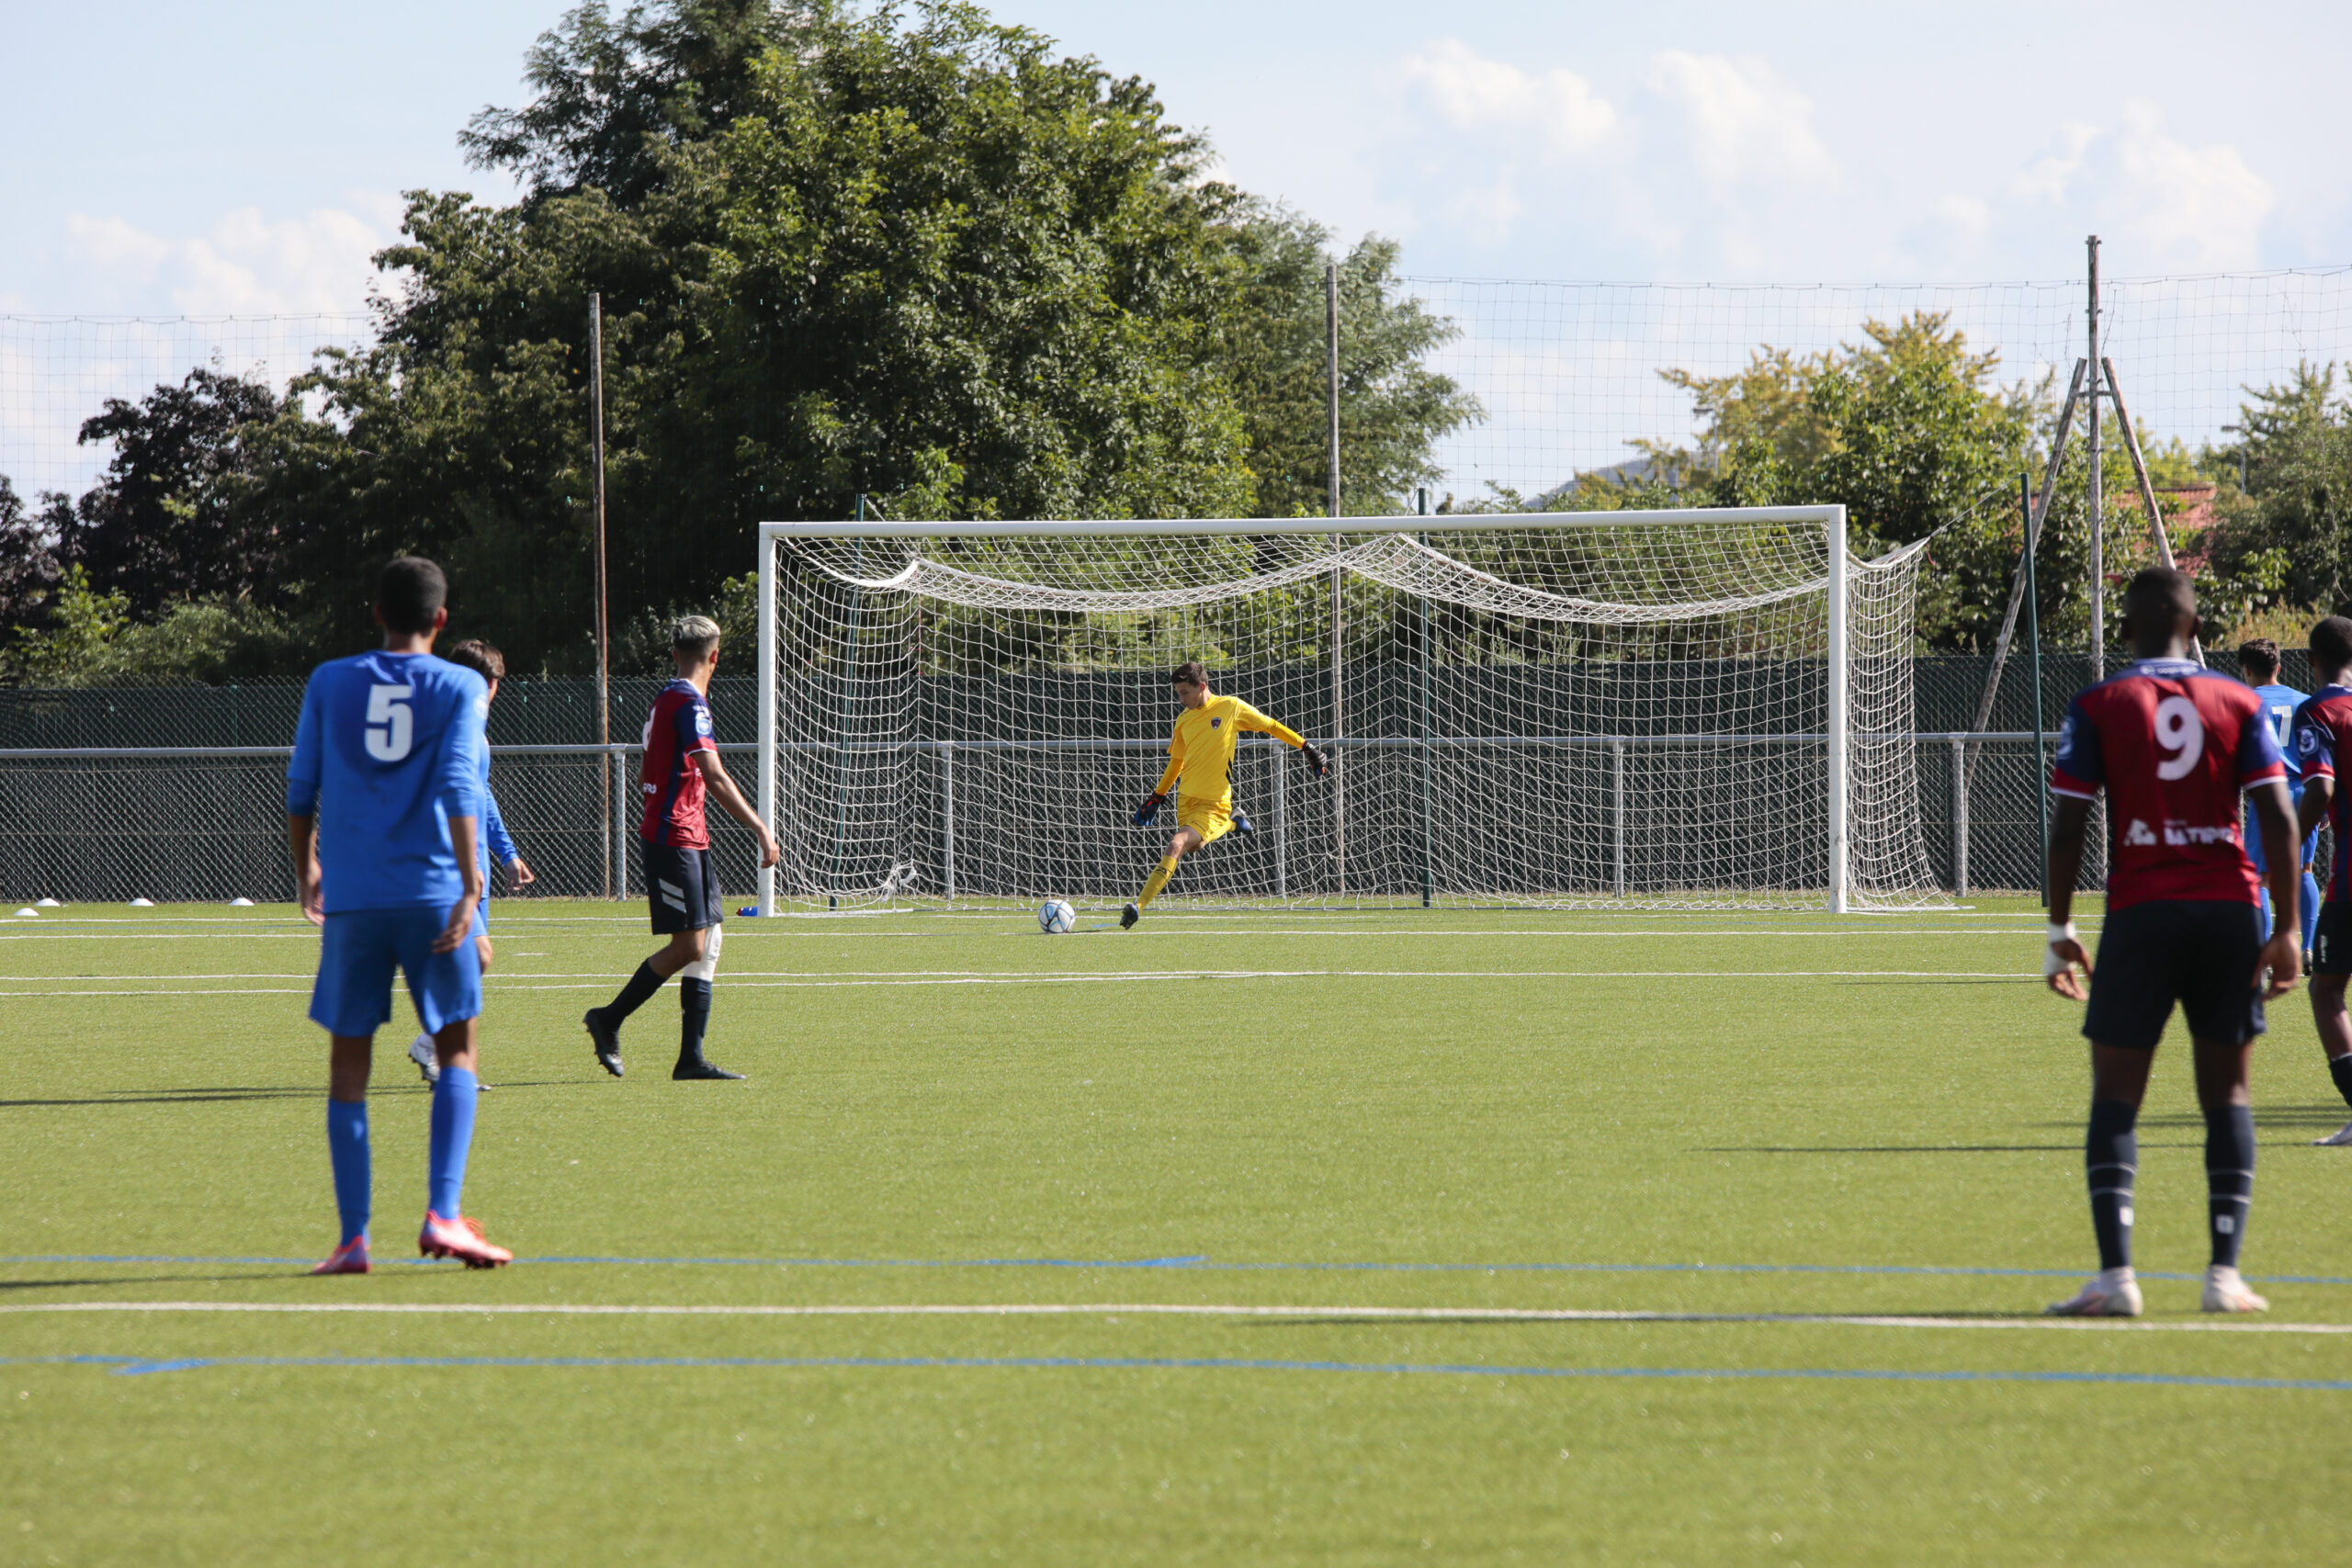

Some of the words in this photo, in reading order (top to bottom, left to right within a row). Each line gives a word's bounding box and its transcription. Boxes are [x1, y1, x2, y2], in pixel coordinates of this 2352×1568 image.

[365, 684, 413, 761] 5
[2154, 695, 2203, 780] 9
[2271, 705, 2292, 747] 7
